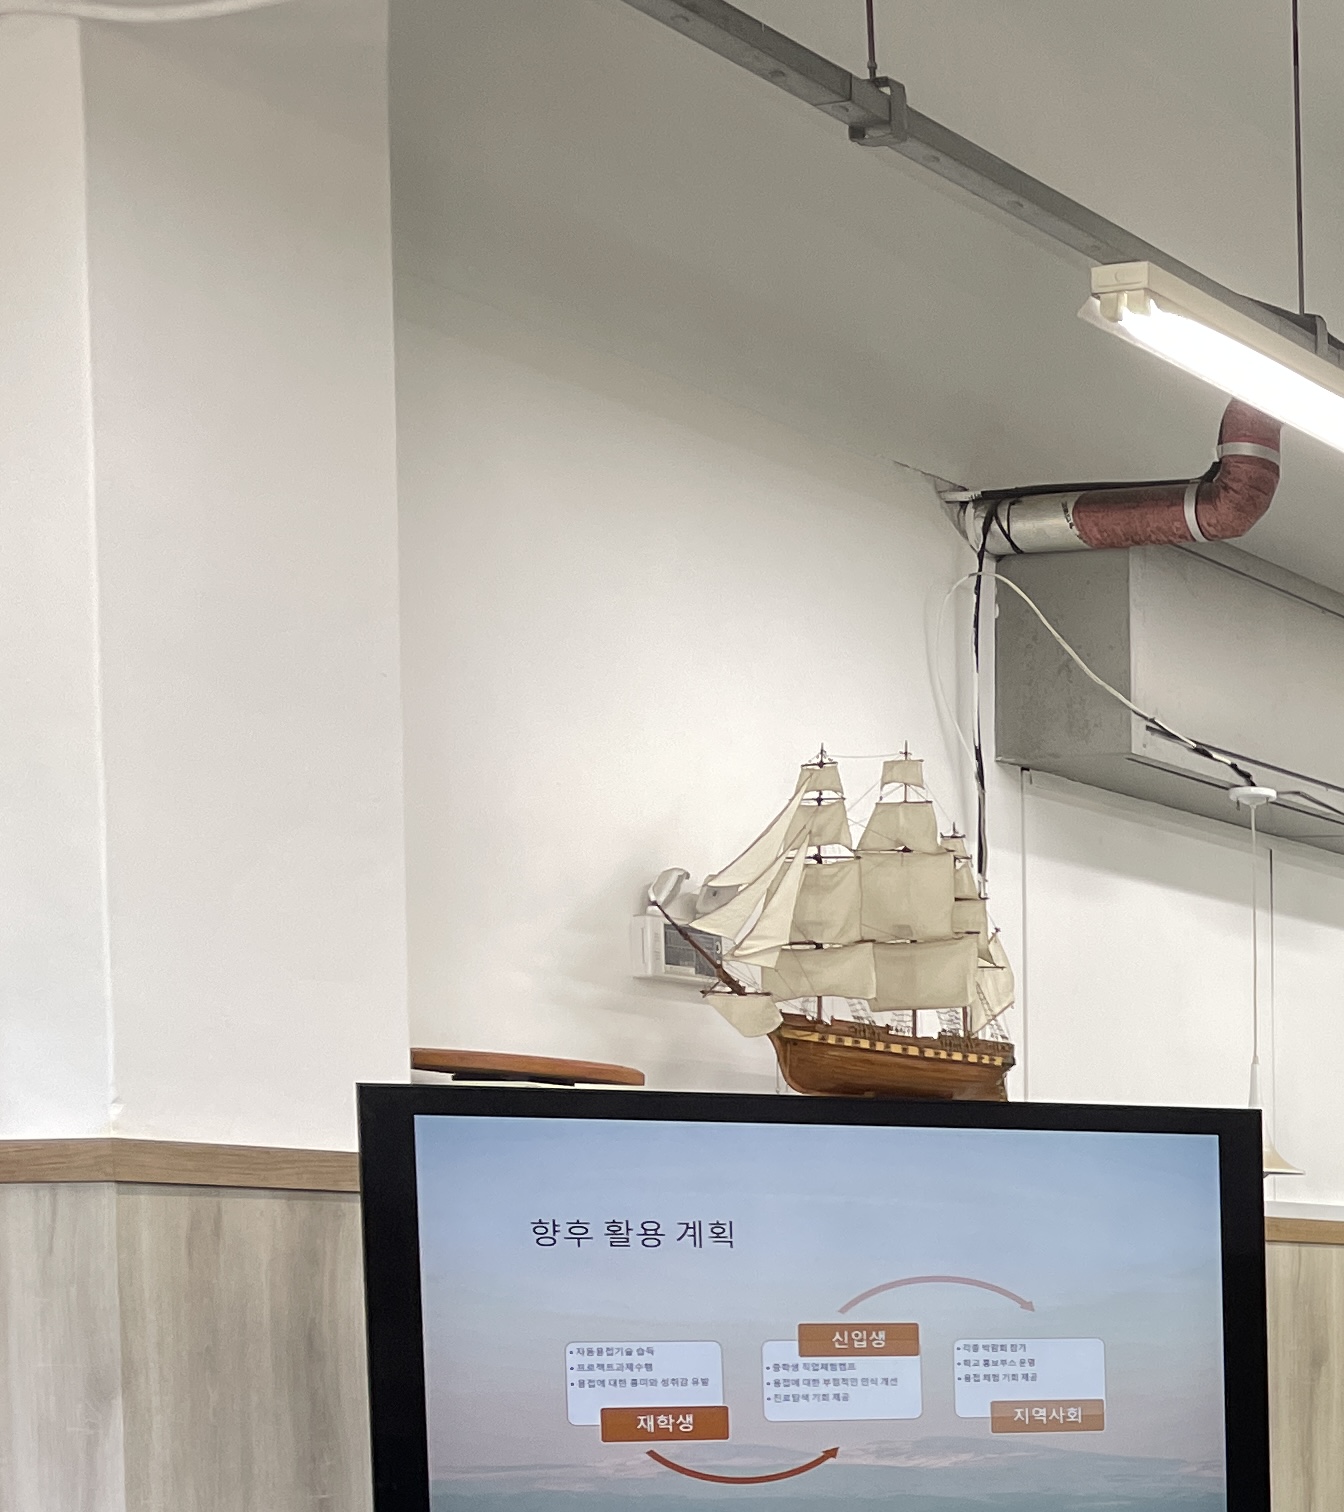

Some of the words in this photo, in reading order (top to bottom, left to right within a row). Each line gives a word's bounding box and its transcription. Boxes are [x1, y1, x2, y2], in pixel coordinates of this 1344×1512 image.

[530, 1218, 594, 1248] 향후
[603, 1219, 666, 1249] 활용
[676, 1219, 734, 1249] 계획
[832, 1330, 886, 1349] 신입생
[636, 1414, 694, 1433] 재학생
[1013, 1406, 1083, 1425] 지역사회
